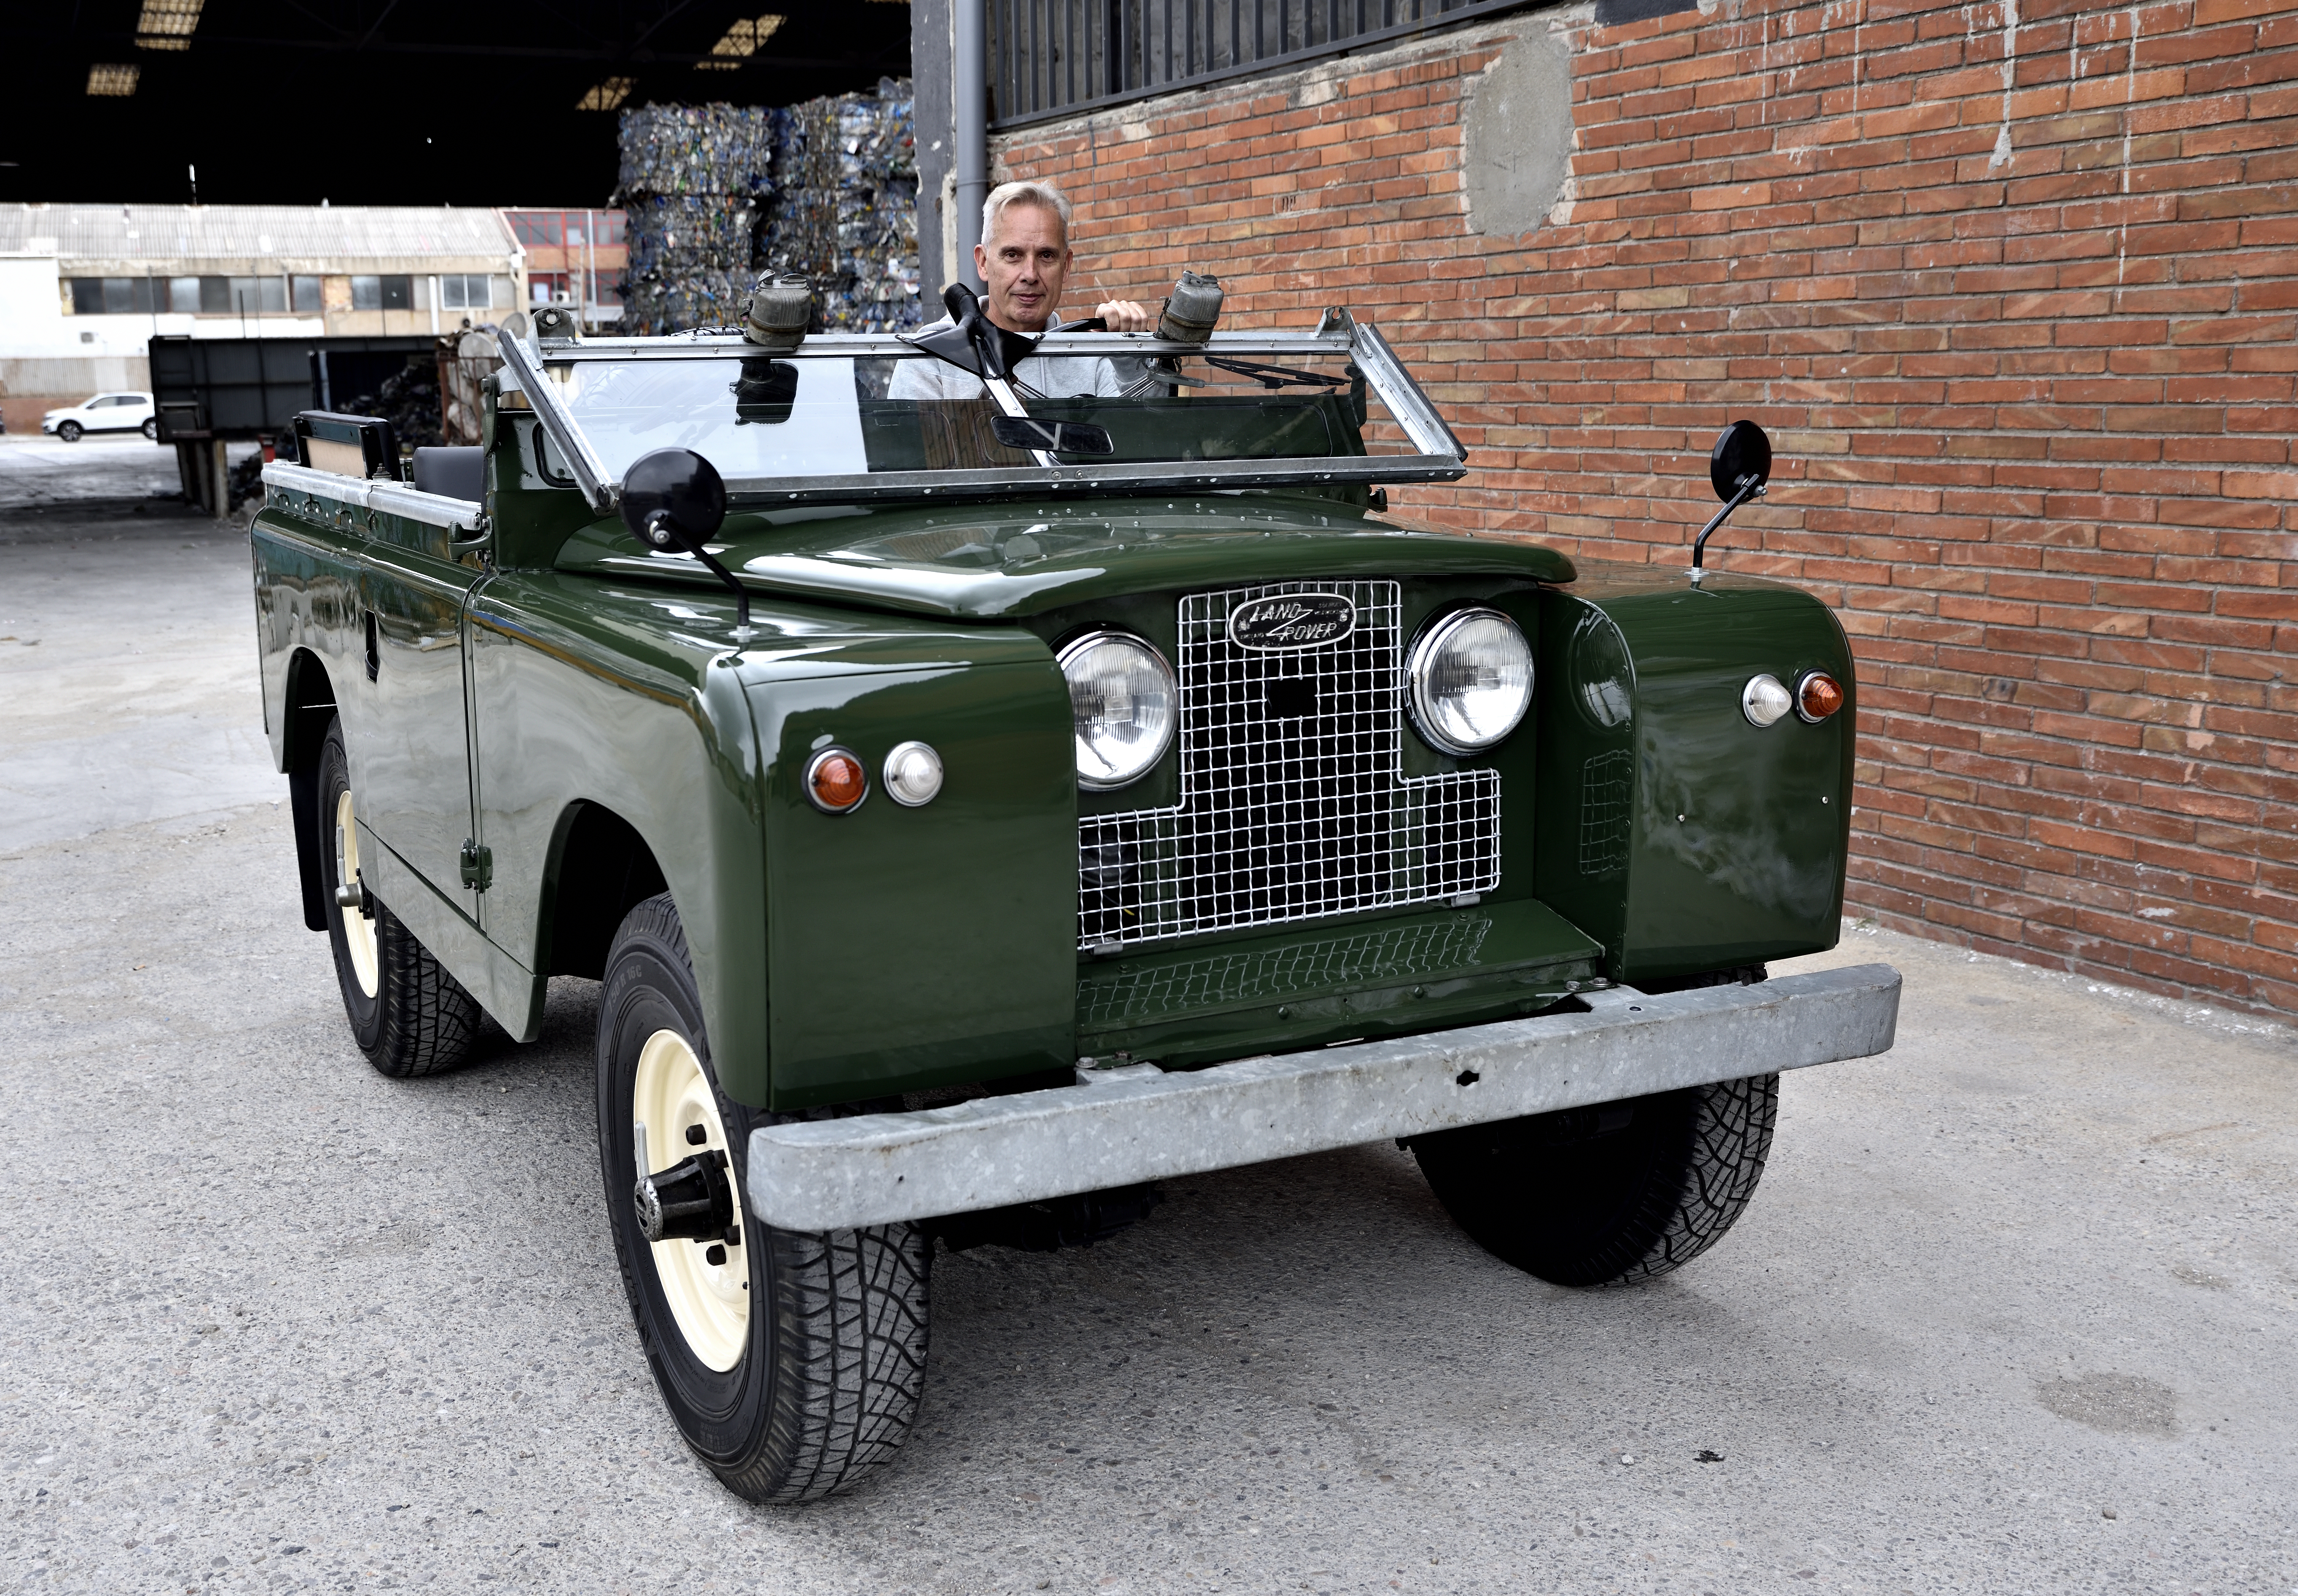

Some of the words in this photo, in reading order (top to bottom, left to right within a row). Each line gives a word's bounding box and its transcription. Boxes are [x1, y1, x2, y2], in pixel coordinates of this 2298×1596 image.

[1249, 603, 1301, 623] LAND
[1280, 622, 1337, 641] ROVER
[608, 982, 620, 1014] 7.50
[620, 973, 626, 987] R
[626, 964, 642, 980] 16C
